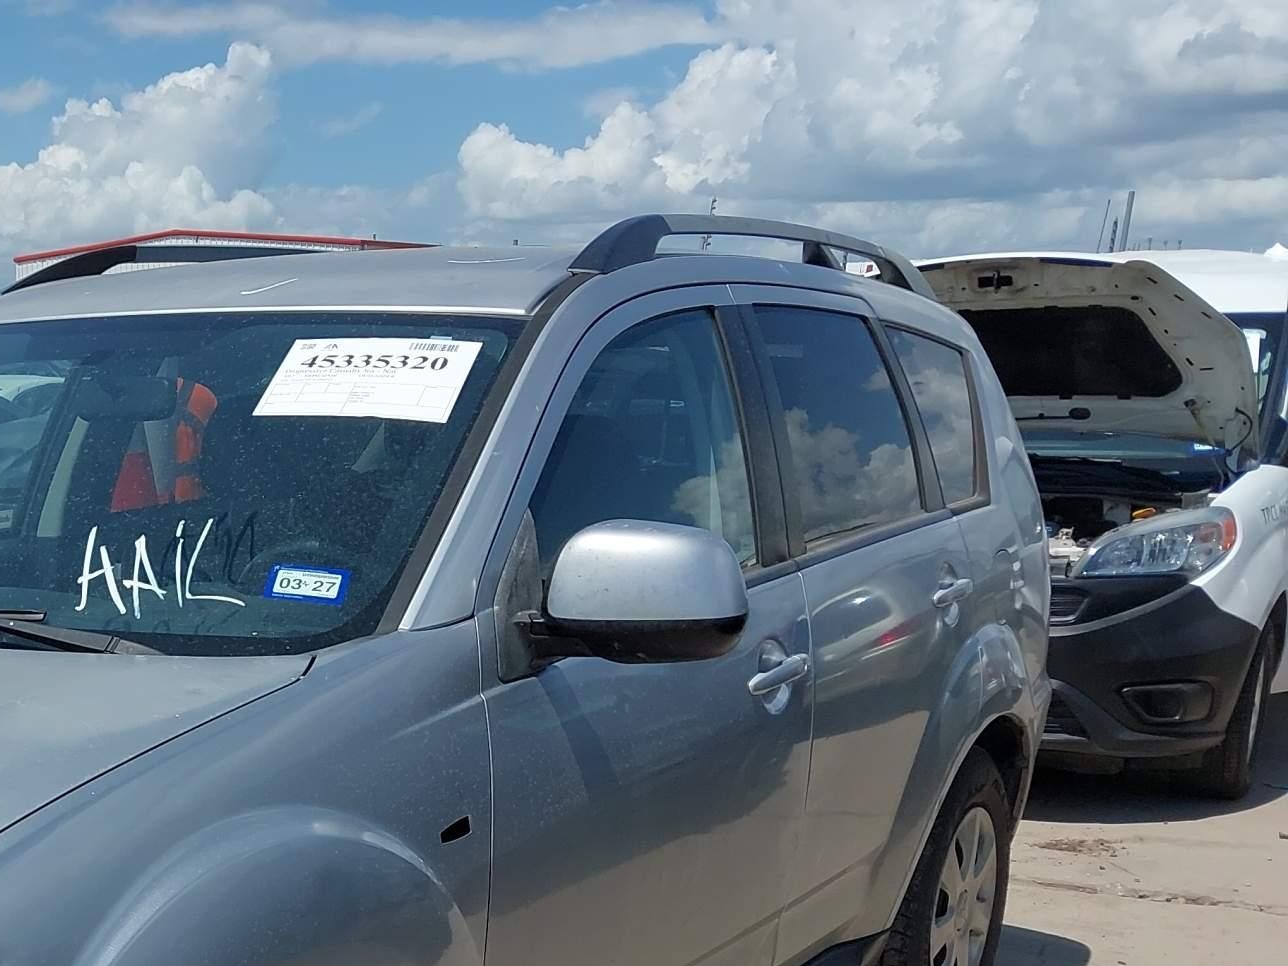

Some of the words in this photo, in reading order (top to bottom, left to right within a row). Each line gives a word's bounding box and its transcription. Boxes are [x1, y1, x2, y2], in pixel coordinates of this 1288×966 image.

[301, 354, 449, 371] 45335320
[279, 577, 302, 590] 03
[311, 580, 337, 593] 27
